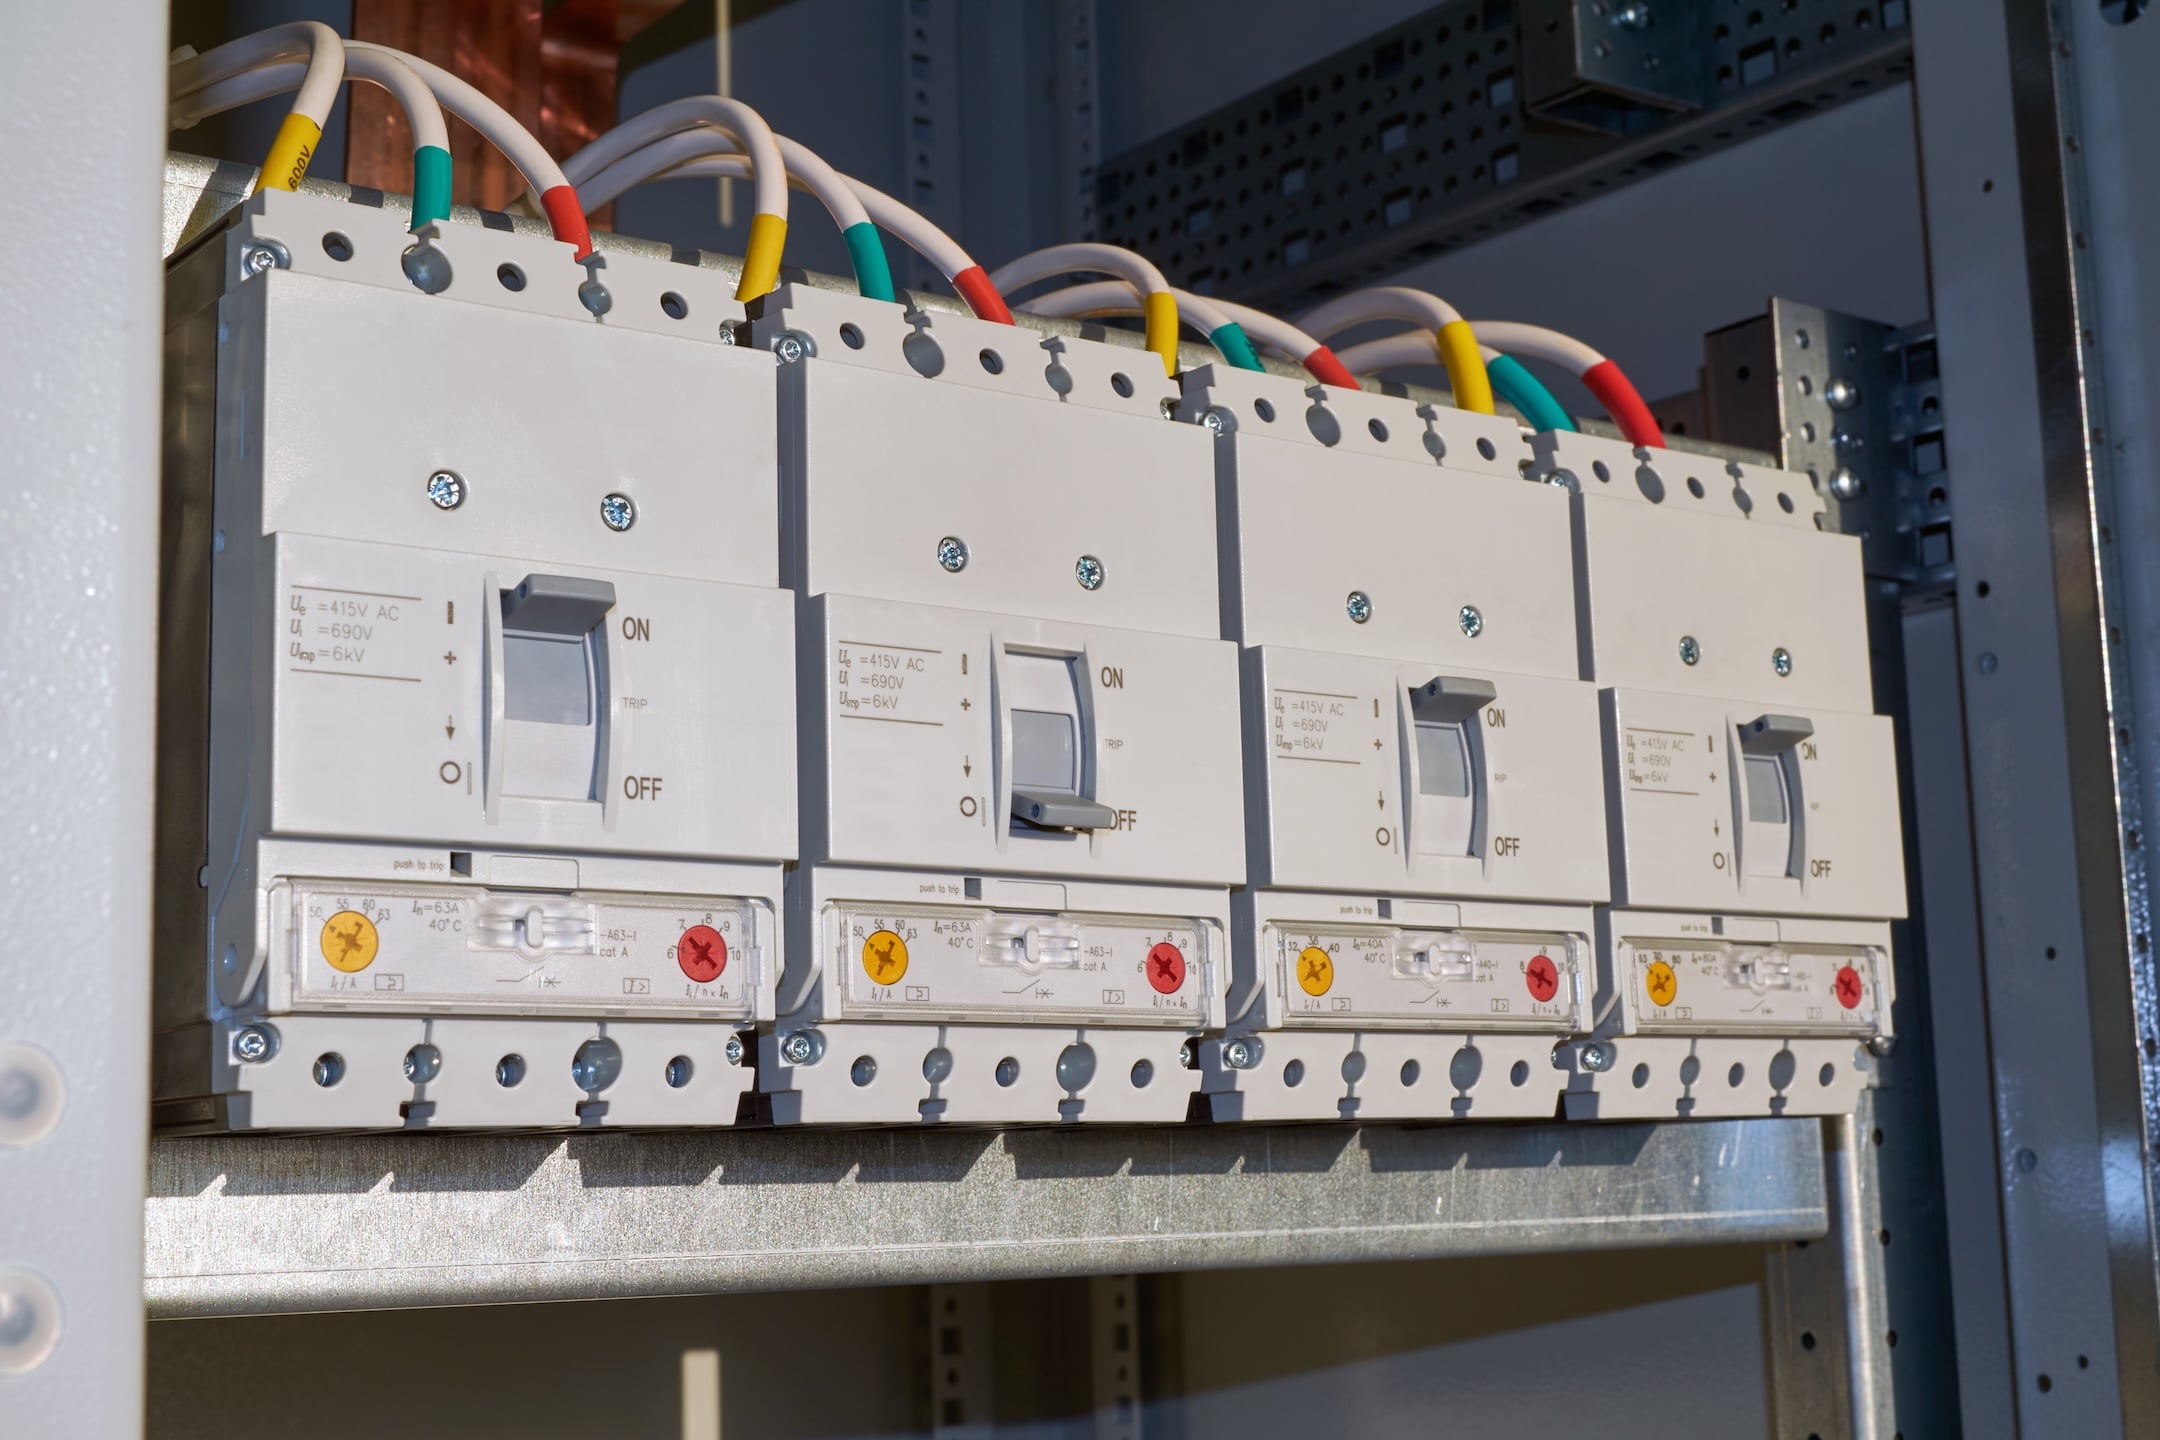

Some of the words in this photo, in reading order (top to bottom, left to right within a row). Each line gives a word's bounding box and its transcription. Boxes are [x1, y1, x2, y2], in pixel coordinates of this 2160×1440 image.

[288, 144, 310, 190] 600V
[376, 605, 400, 621] AC
[622, 616, 650, 642] ON
[906, 657, 925, 672] AC
[1101, 666, 1124, 689] ON
[622, 697, 648, 709] TRIP
[1329, 703, 1344, 716] AC
[1487, 707, 1506, 728] ON
[624, 775, 663, 801] OFF
[1494, 836, 1520, 857] OFF
[393, 860, 414, 870] push
[417, 860, 427, 870] to
[430, 861, 445, 872] trip
[1810, 859, 1832, 878] OFF
[919, 885, 936, 894] push
[939, 884, 946, 893] to
[948, 885, 960, 895] trip
[336, 898, 349, 910] 55
[362, 899, 375, 911] 60
[309, 906, 323, 918] 50
[378, 908, 391, 921] 63
[705, 913, 713, 924] 8
[874, 919, 885, 929] 55
[895, 919, 905, 930] 60
[723, 921, 730, 932] 9
[853, 926, 864, 937] 50
[907, 928, 918, 939] 63
[600, 947, 616, 957] cat
[622, 947, 629, 957] A
[1287, 941, 1297, 952] 32
[1329, 943, 1340, 953] 40
[667, 948, 674, 959] 6
